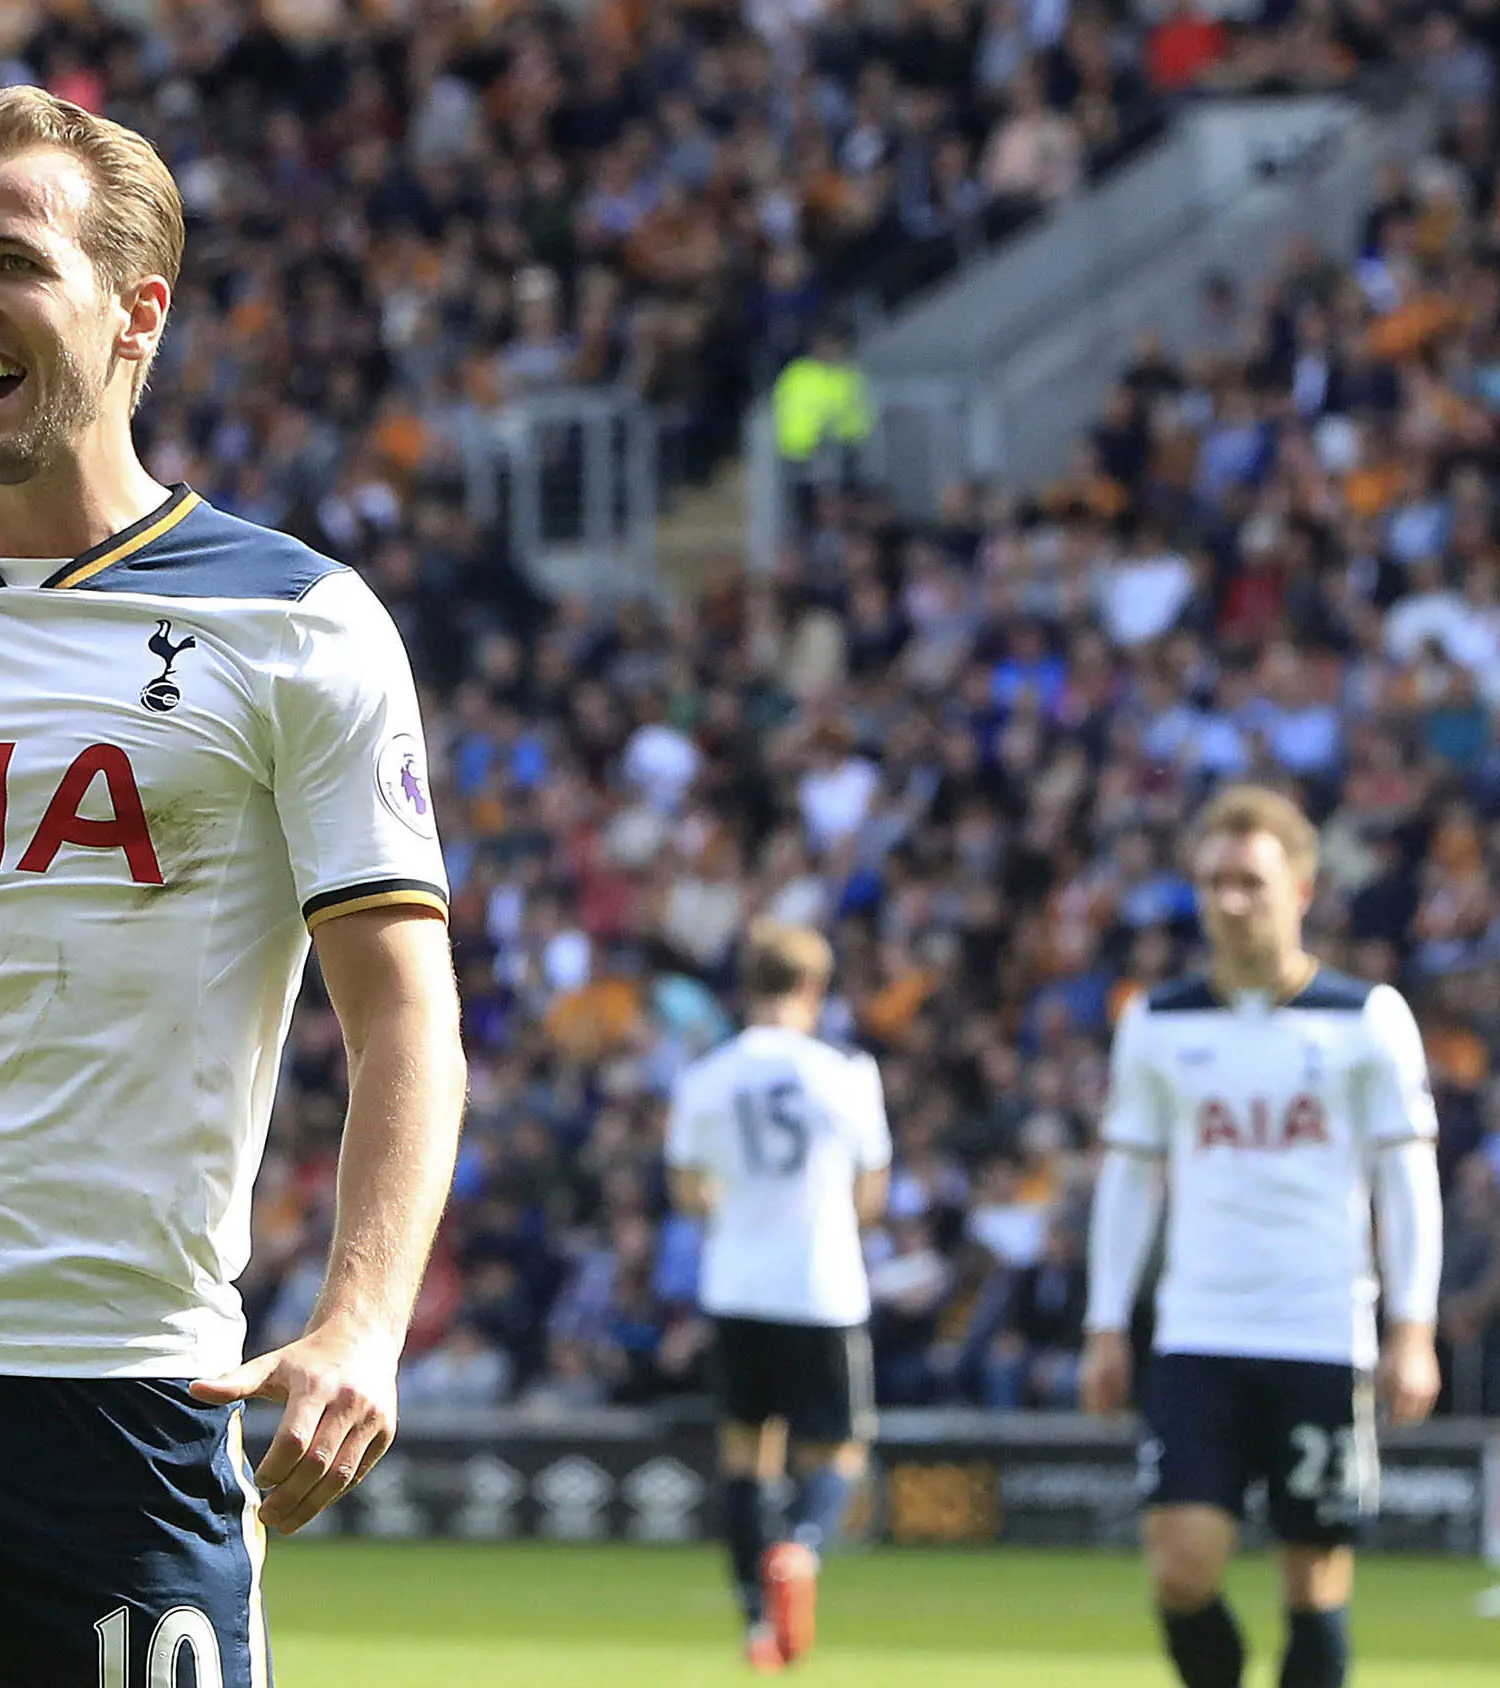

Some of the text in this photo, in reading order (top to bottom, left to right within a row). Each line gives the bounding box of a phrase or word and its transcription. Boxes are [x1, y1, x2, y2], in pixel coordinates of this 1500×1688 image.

[732, 1082, 809, 1178] 15
[1193, 1092, 1331, 1153] AIA
[93, 1605, 224, 1688] 10
